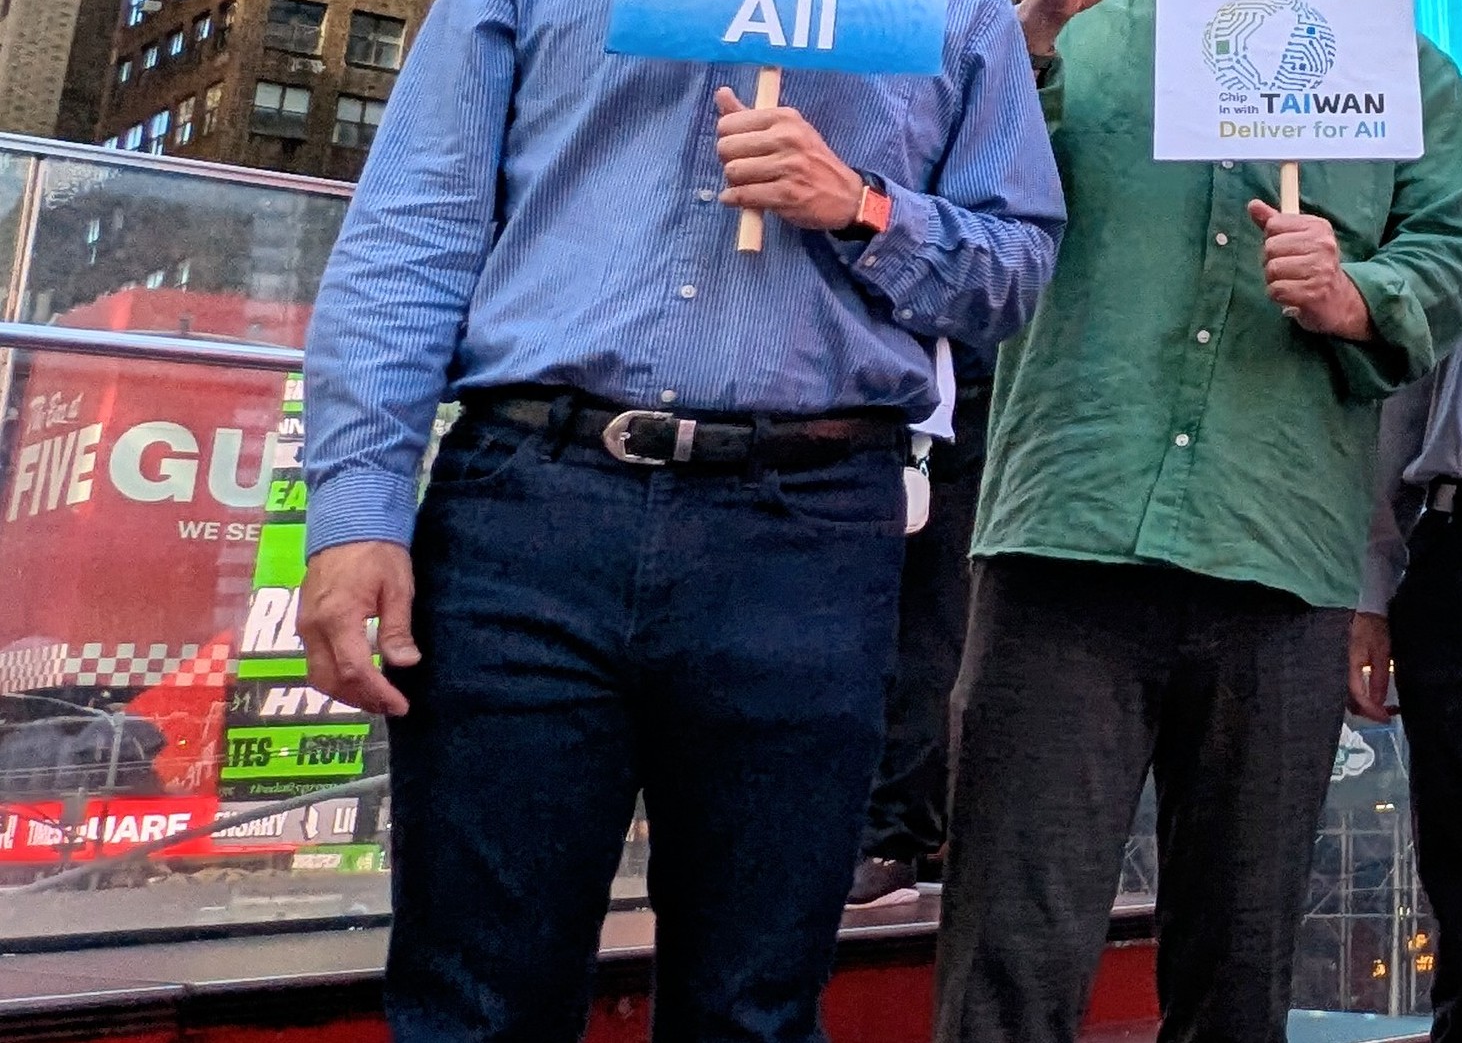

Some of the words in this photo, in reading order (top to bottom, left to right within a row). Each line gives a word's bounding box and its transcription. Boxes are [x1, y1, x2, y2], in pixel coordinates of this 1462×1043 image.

[1218, 92, 1248, 104] Chip
[1260, 93, 1385, 114] TAIWAN
[1234, 105, 1259, 114] with
[1219, 121, 1307, 138] Deliver
[1314, 120, 1349, 138] for
[1354, 121, 1386, 138] All
[6, 422, 103, 523] FIVE
[178, 520, 221, 541] WE
